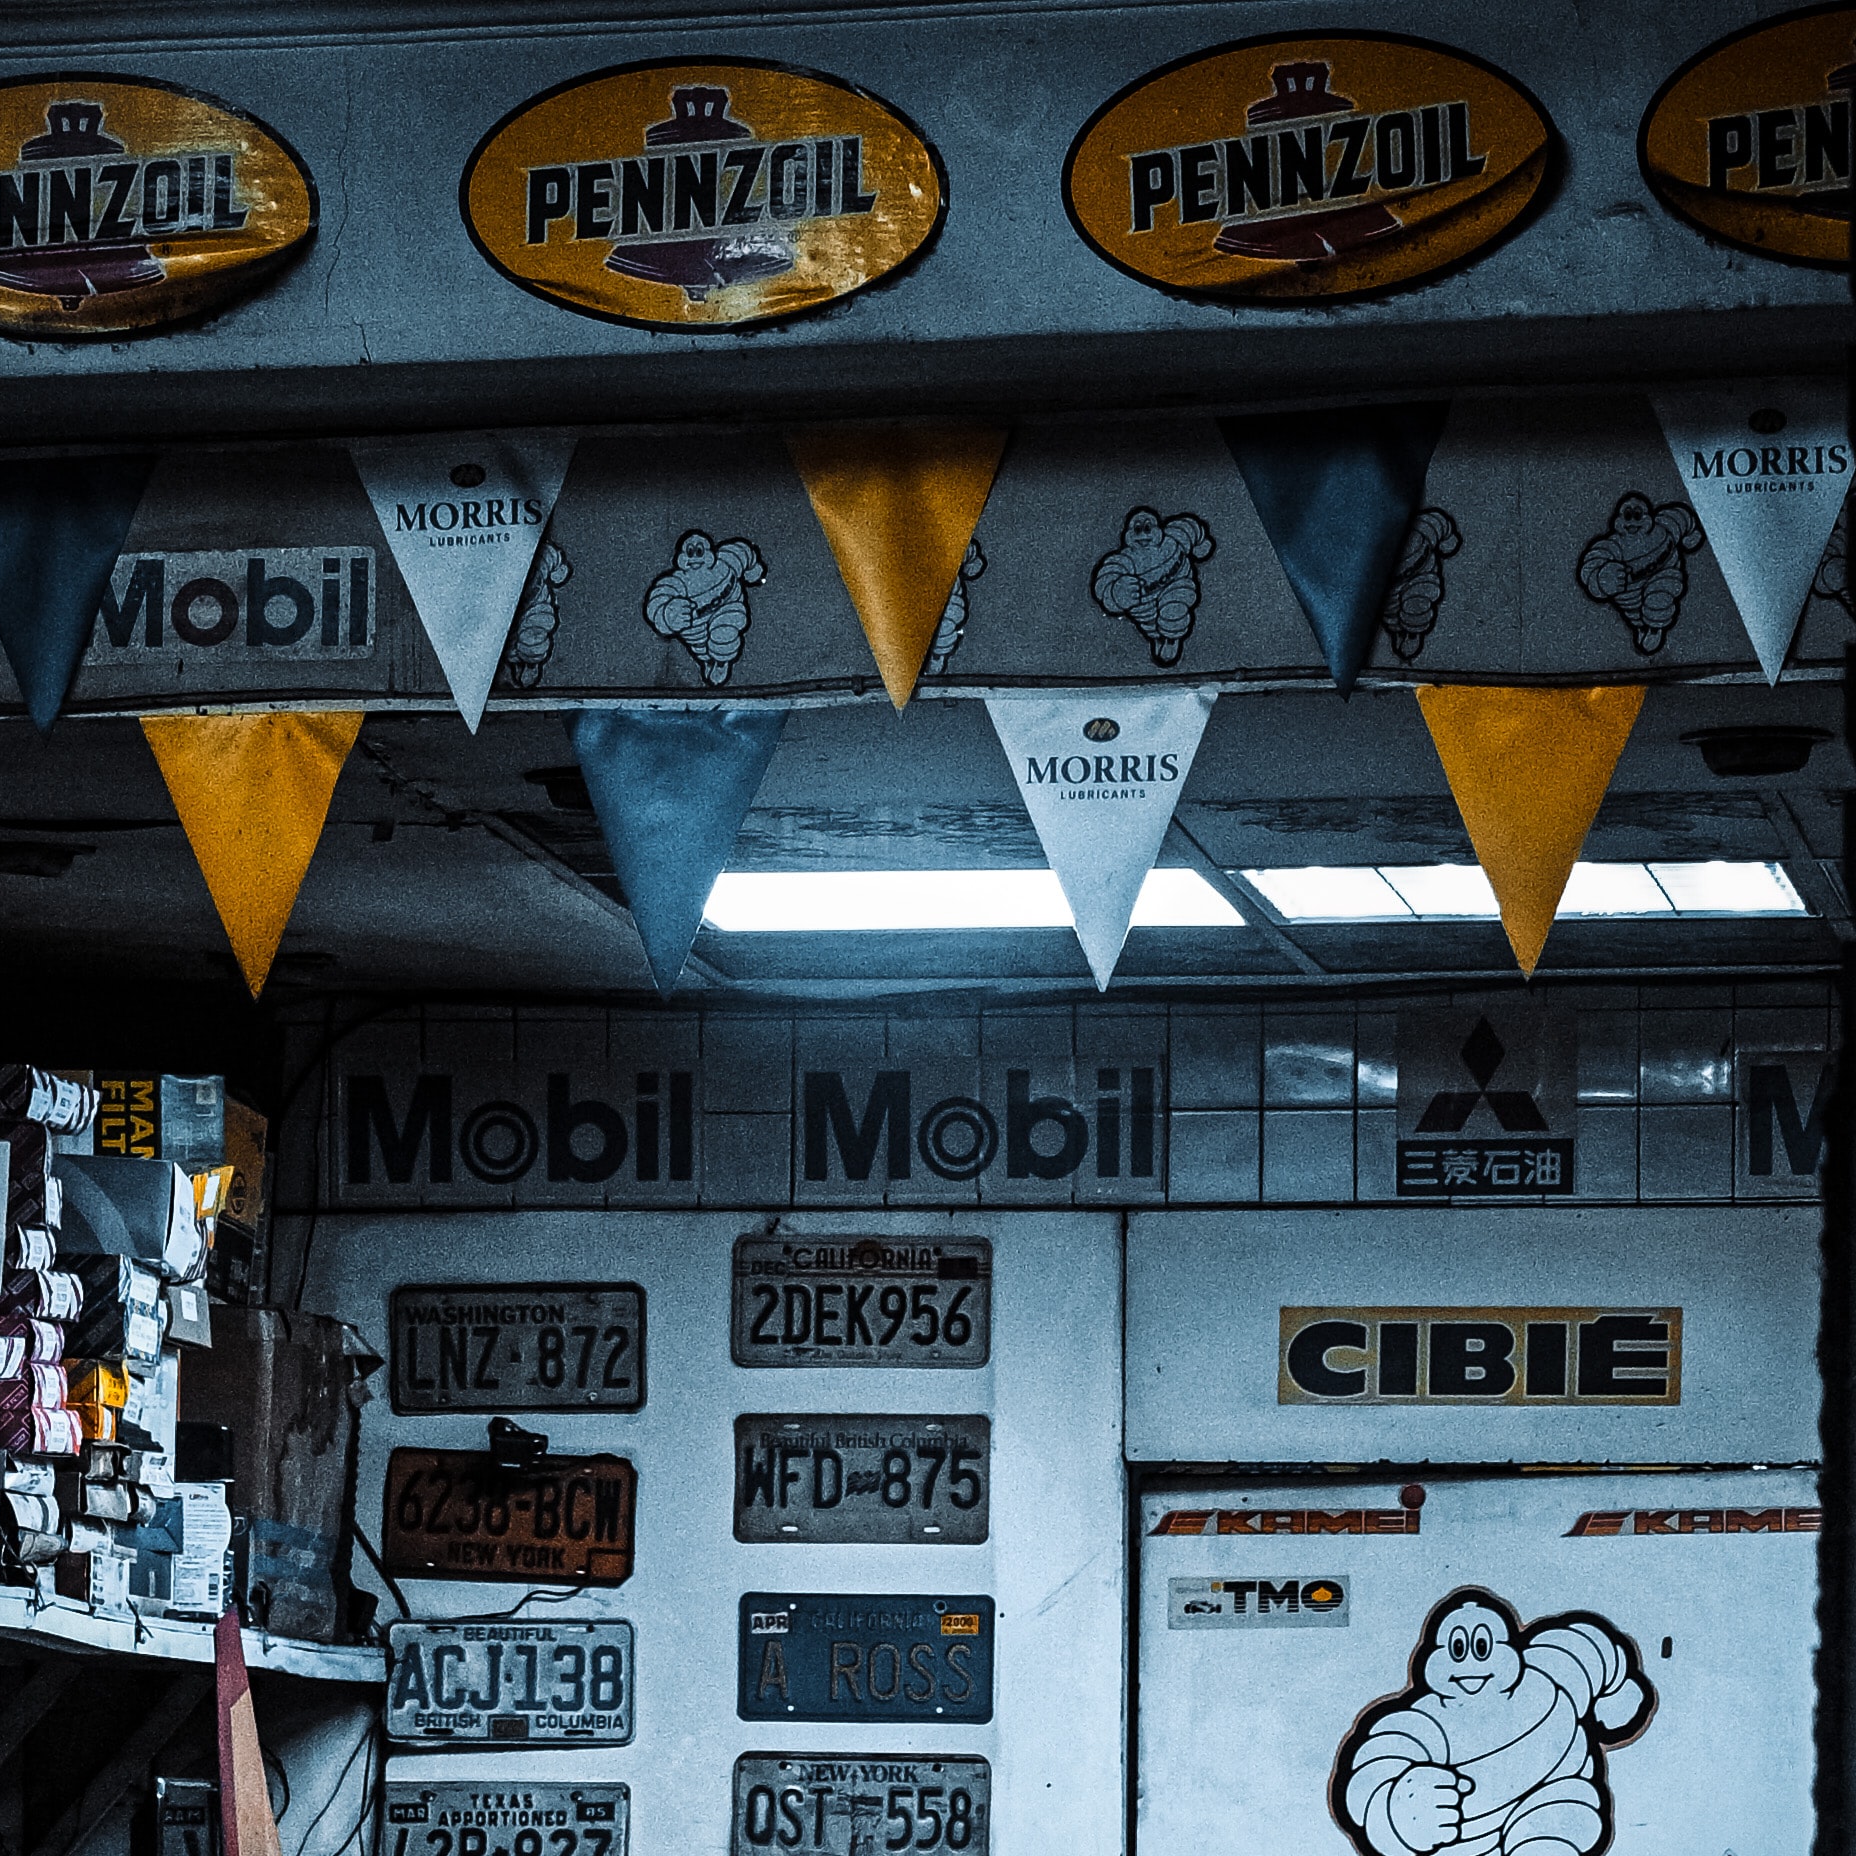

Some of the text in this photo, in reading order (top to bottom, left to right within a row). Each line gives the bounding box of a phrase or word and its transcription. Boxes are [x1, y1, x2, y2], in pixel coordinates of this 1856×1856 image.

[1130, 102, 1486, 233] PENNZOIL
[526, 137, 877, 245] PENNZOIL
[1692, 444, 1848, 479] MORRIS
[1726, 480, 1817, 494] LUBRICANTS
[394, 498, 544, 533] MORRIS
[428, 531, 512, 548] LUBRICANTS
[90, 557, 370, 648] Mobil
[1026, 753, 1180, 785] MORRIS
[1060, 788, 1147, 801] LUBRICANTS
[347, 1070, 693, 1185] Mobil
[803, 1067, 1154, 1182] Mobil
[1403, 1148, 1562, 1188] 三菱石油
[791, 1247, 931, 1271] CALIFORNIA
[403, 1303, 565, 1325] WASHINGTON
[749, 1285, 972, 1348] 2DEK956
[835, 1431, 886, 1450] British
[890, 1431, 969, 1450] Columbia
[447, 1542, 565, 1569] NEW YORK
[752, 1615, 787, 1632] APR
[810, 1612, 926, 1631] CALIFORNIA
[463, 1627, 557, 1643] BEAUTIFUL
[757, 1640, 974, 1701] A ROSS
[414, 1713, 482, 1730] BRITISH
[535, 1714, 625, 1731] COLUMBIA
[799, 1763, 918, 1783] NEW YORK
[470, 1792, 534, 1810] TEXAS
[439, 1808, 568, 1828] APPORTIONED
